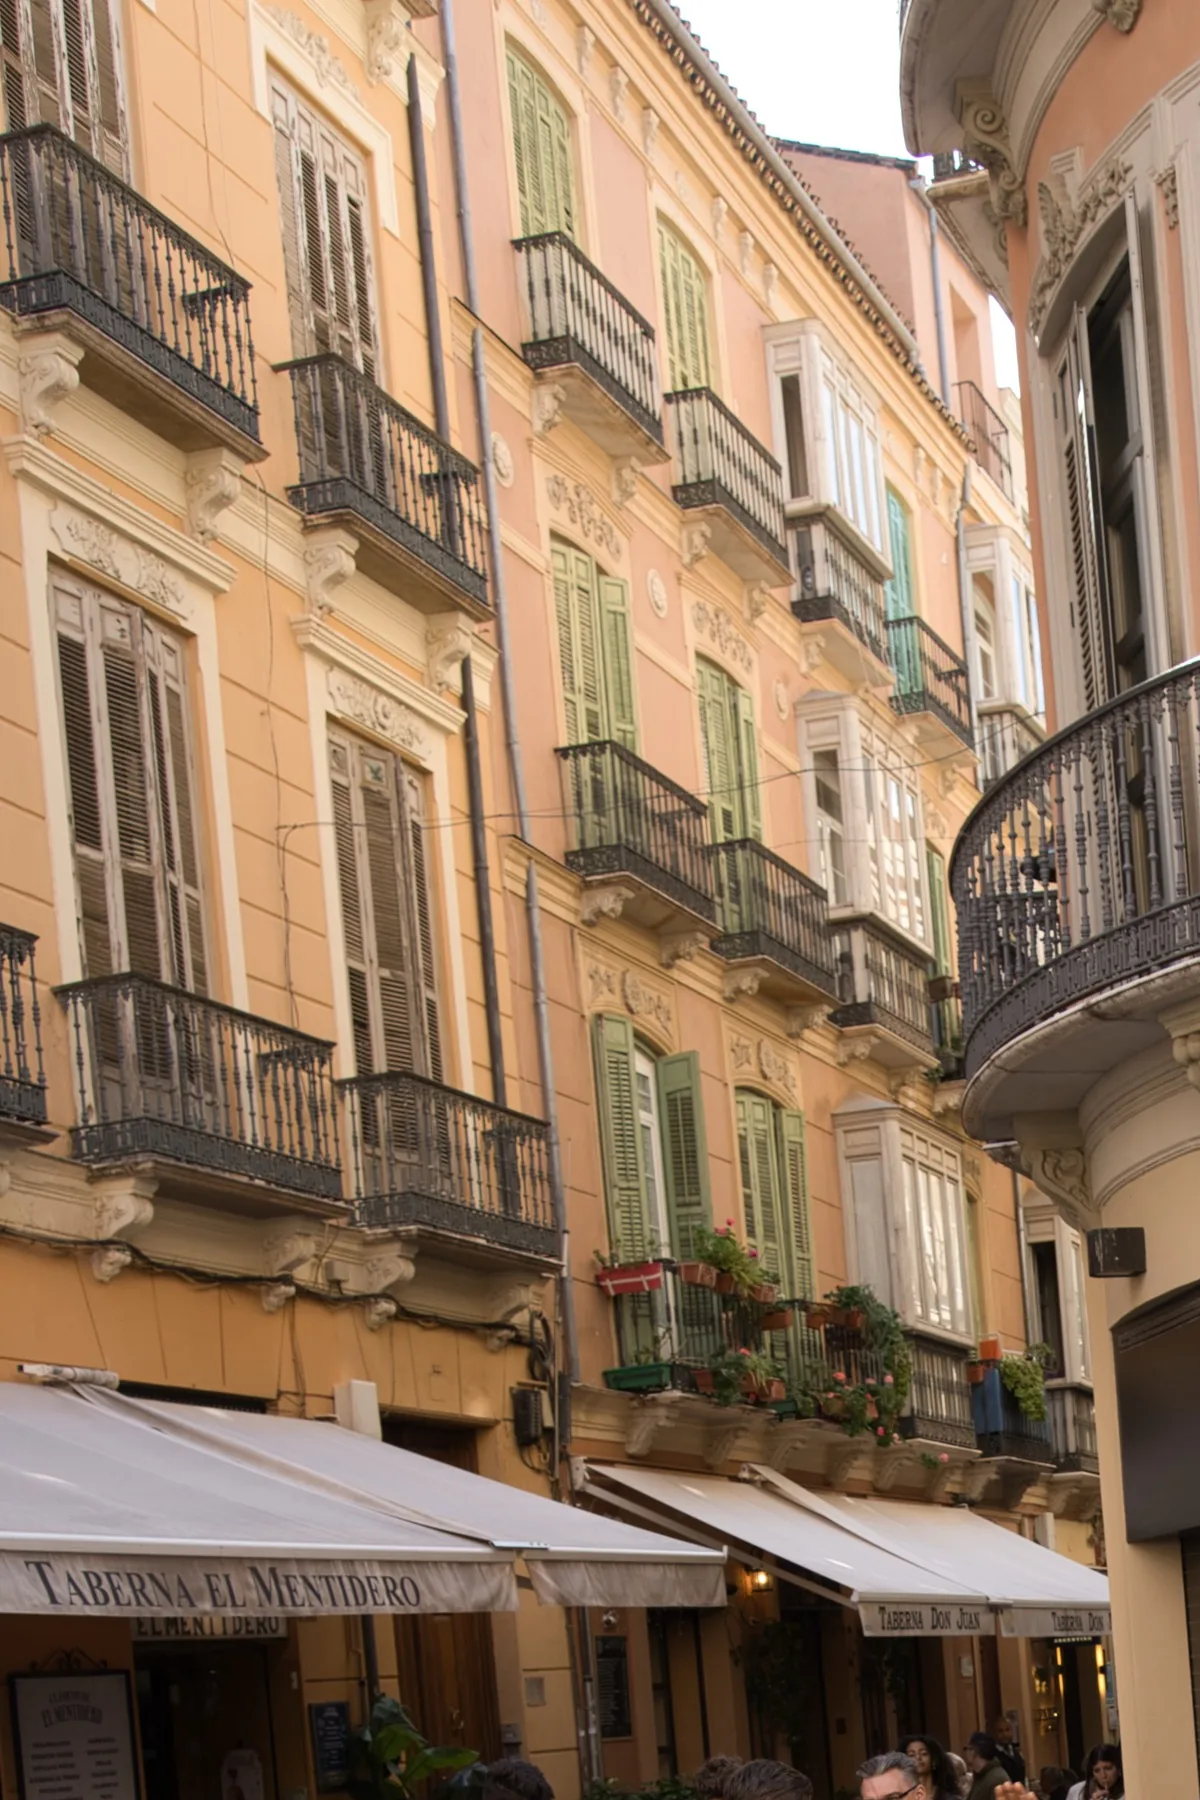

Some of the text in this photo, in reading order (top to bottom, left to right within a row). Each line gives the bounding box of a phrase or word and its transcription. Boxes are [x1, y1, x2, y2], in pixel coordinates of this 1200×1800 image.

[24, 1559, 422, 1608] TABERNA EL MENTIDERO
[878, 1606, 980, 1631] TABERNA DON JUAN
